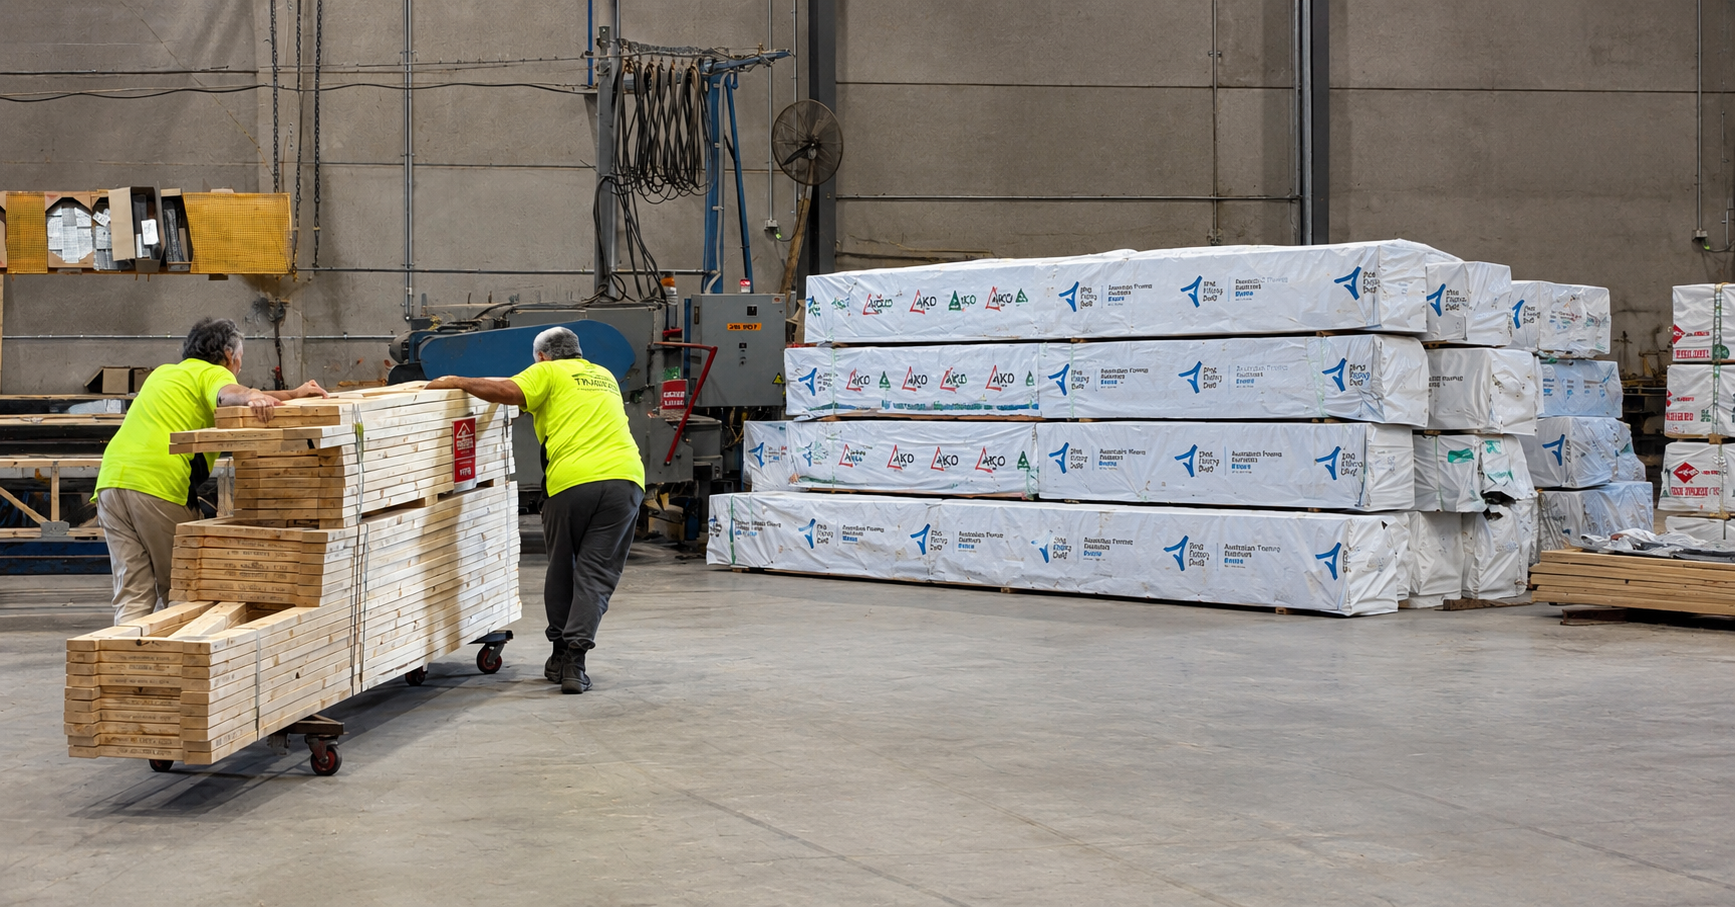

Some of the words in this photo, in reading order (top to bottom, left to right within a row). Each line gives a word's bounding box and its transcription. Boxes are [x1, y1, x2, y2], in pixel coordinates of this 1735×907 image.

[992, 372, 1015, 386] AKO
[893, 453, 915, 467] AKO
[937, 454, 959, 469] AKO
